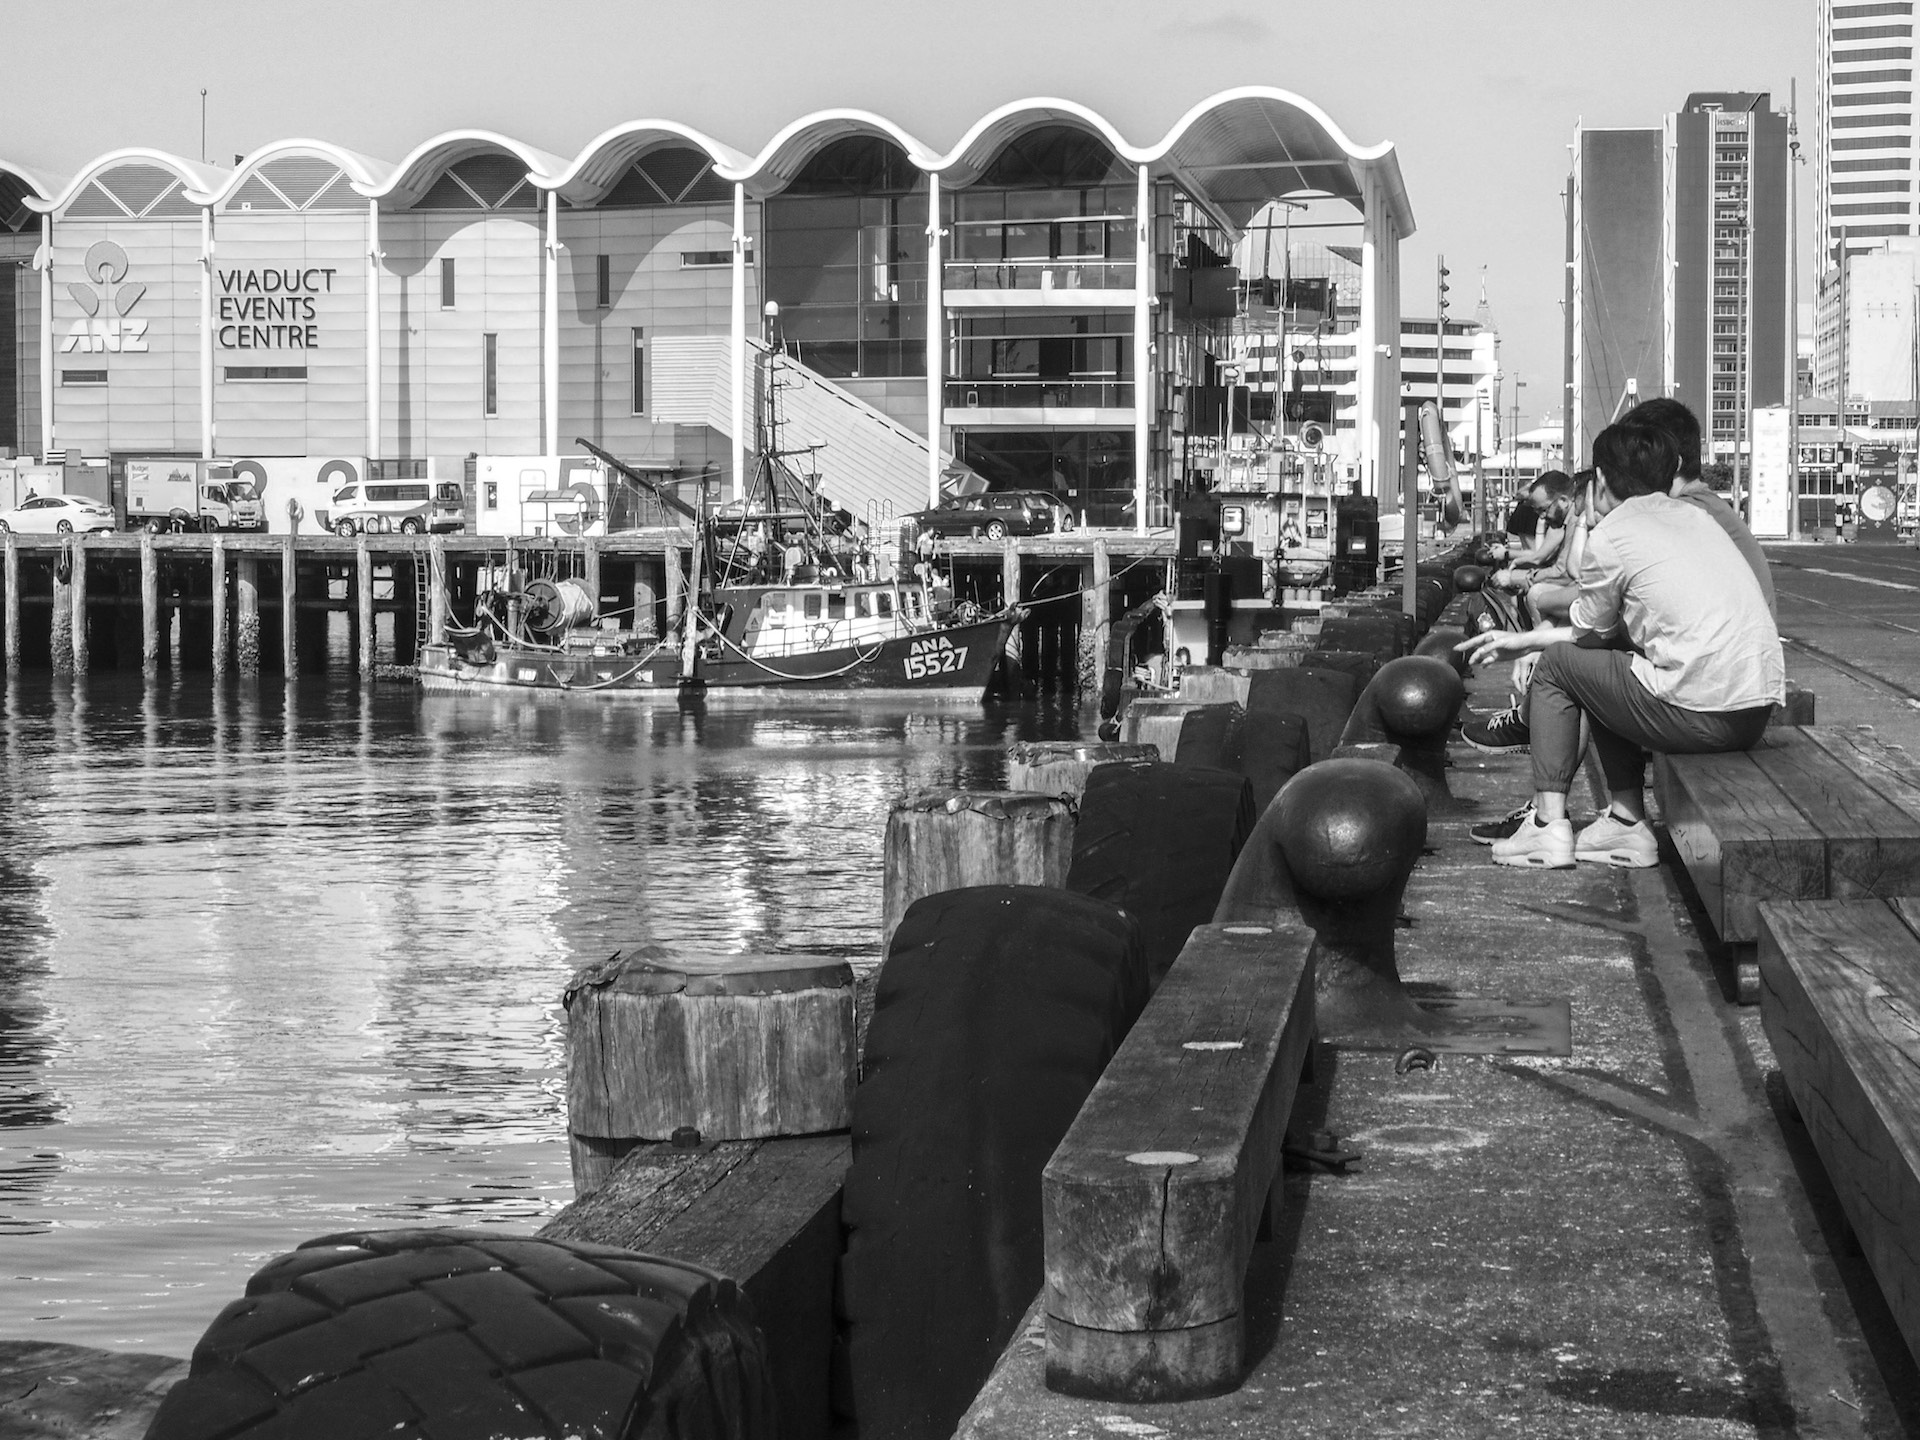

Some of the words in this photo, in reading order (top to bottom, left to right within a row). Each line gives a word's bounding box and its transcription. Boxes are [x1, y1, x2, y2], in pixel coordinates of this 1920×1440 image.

[218, 268, 337, 293] VIADUCT
[219, 296, 316, 321] EVENTS
[59, 319, 150, 353] ANZ
[218, 325, 319, 349] CENTRE
[910, 636, 954, 656] ANA
[903, 646, 969, 680] 15527
